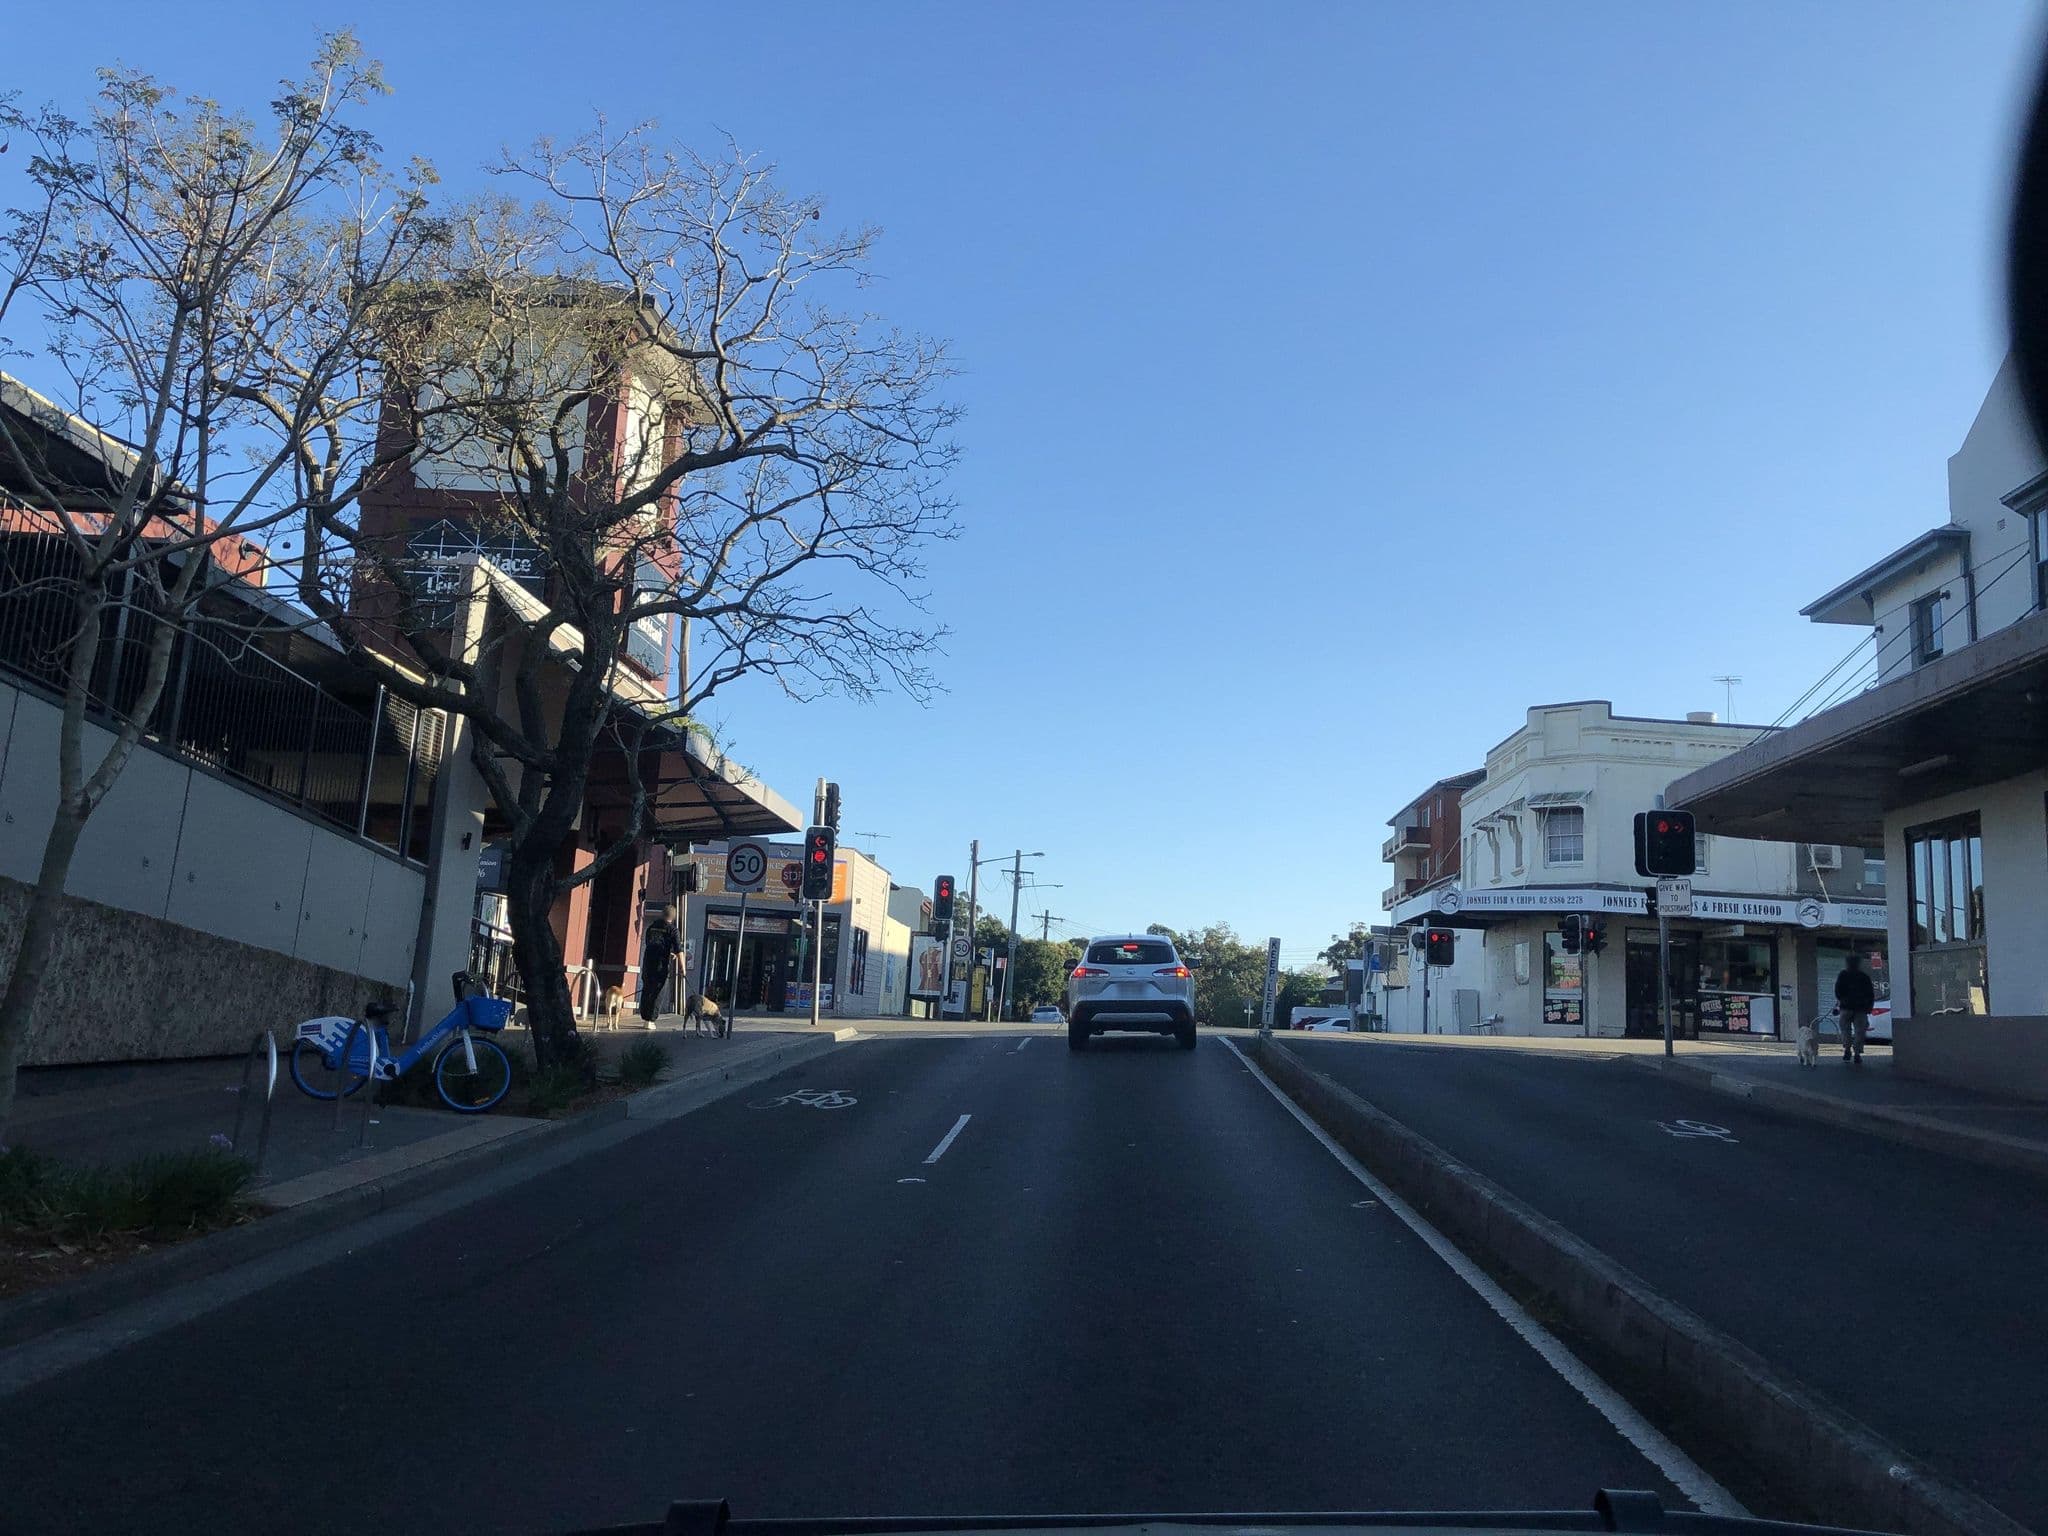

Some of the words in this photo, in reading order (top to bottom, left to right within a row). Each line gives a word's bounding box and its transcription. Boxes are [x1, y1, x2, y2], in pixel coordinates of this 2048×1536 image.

[734, 855, 760, 873] 50
[1493, 895, 1508, 904] FISH
[1602, 895, 1637, 908] JONNIES
[1702, 902, 1708, 911] &
[1712, 902, 1739, 914] FRESH
[1743, 904, 1782, 916] SEAFOOD
[956, 944, 968, 952] 50
[1269, 941, 1277, 977] KEEP
[1265, 983, 1273, 1022] LEFT
